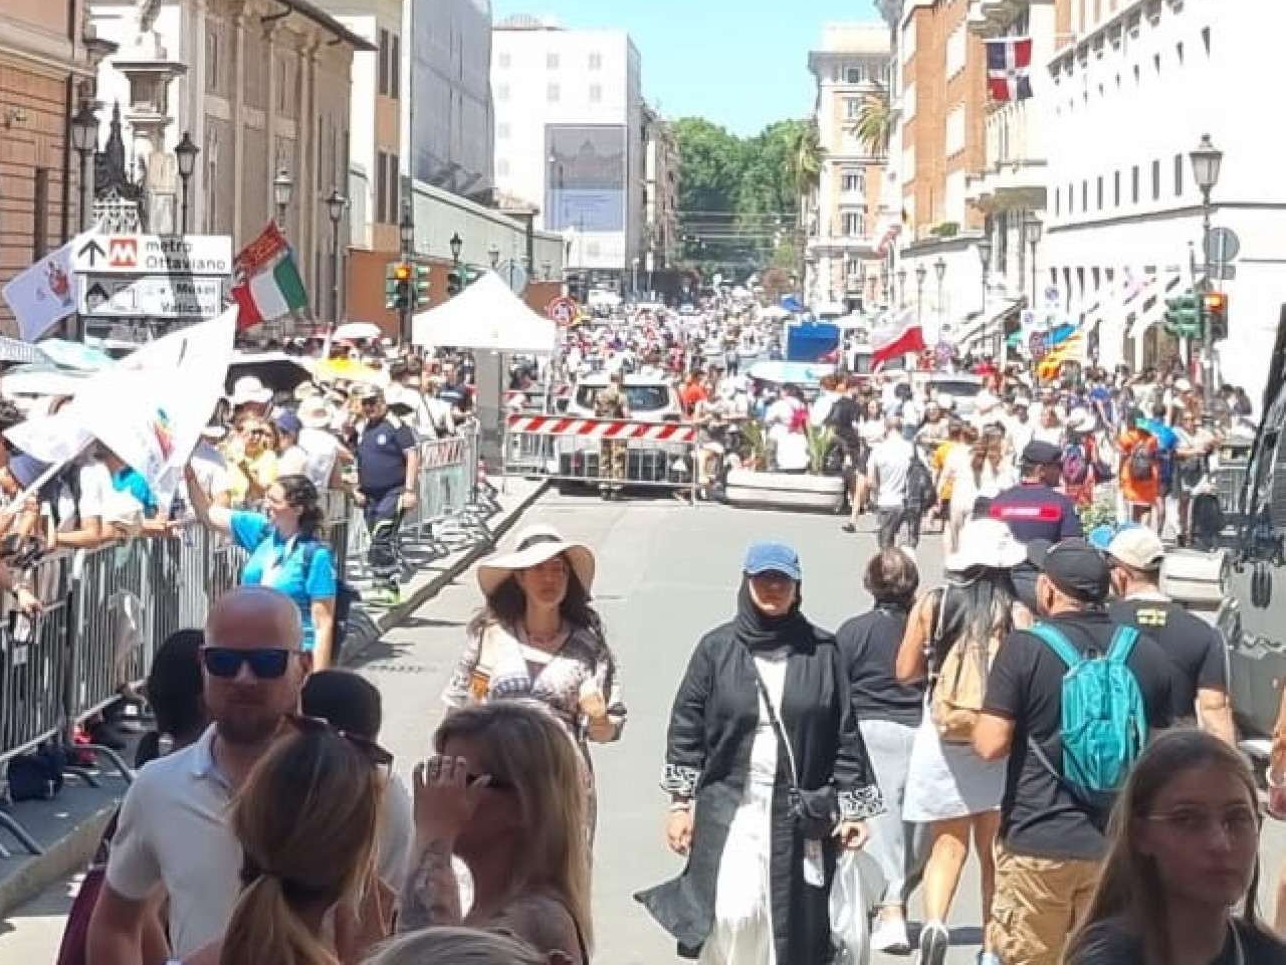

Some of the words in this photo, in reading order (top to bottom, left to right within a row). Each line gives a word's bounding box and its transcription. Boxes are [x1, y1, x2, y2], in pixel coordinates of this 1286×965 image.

[111, 240, 137, 265] M
[146, 240, 192, 252] metro
[146, 254, 226, 269] Ottaviano
